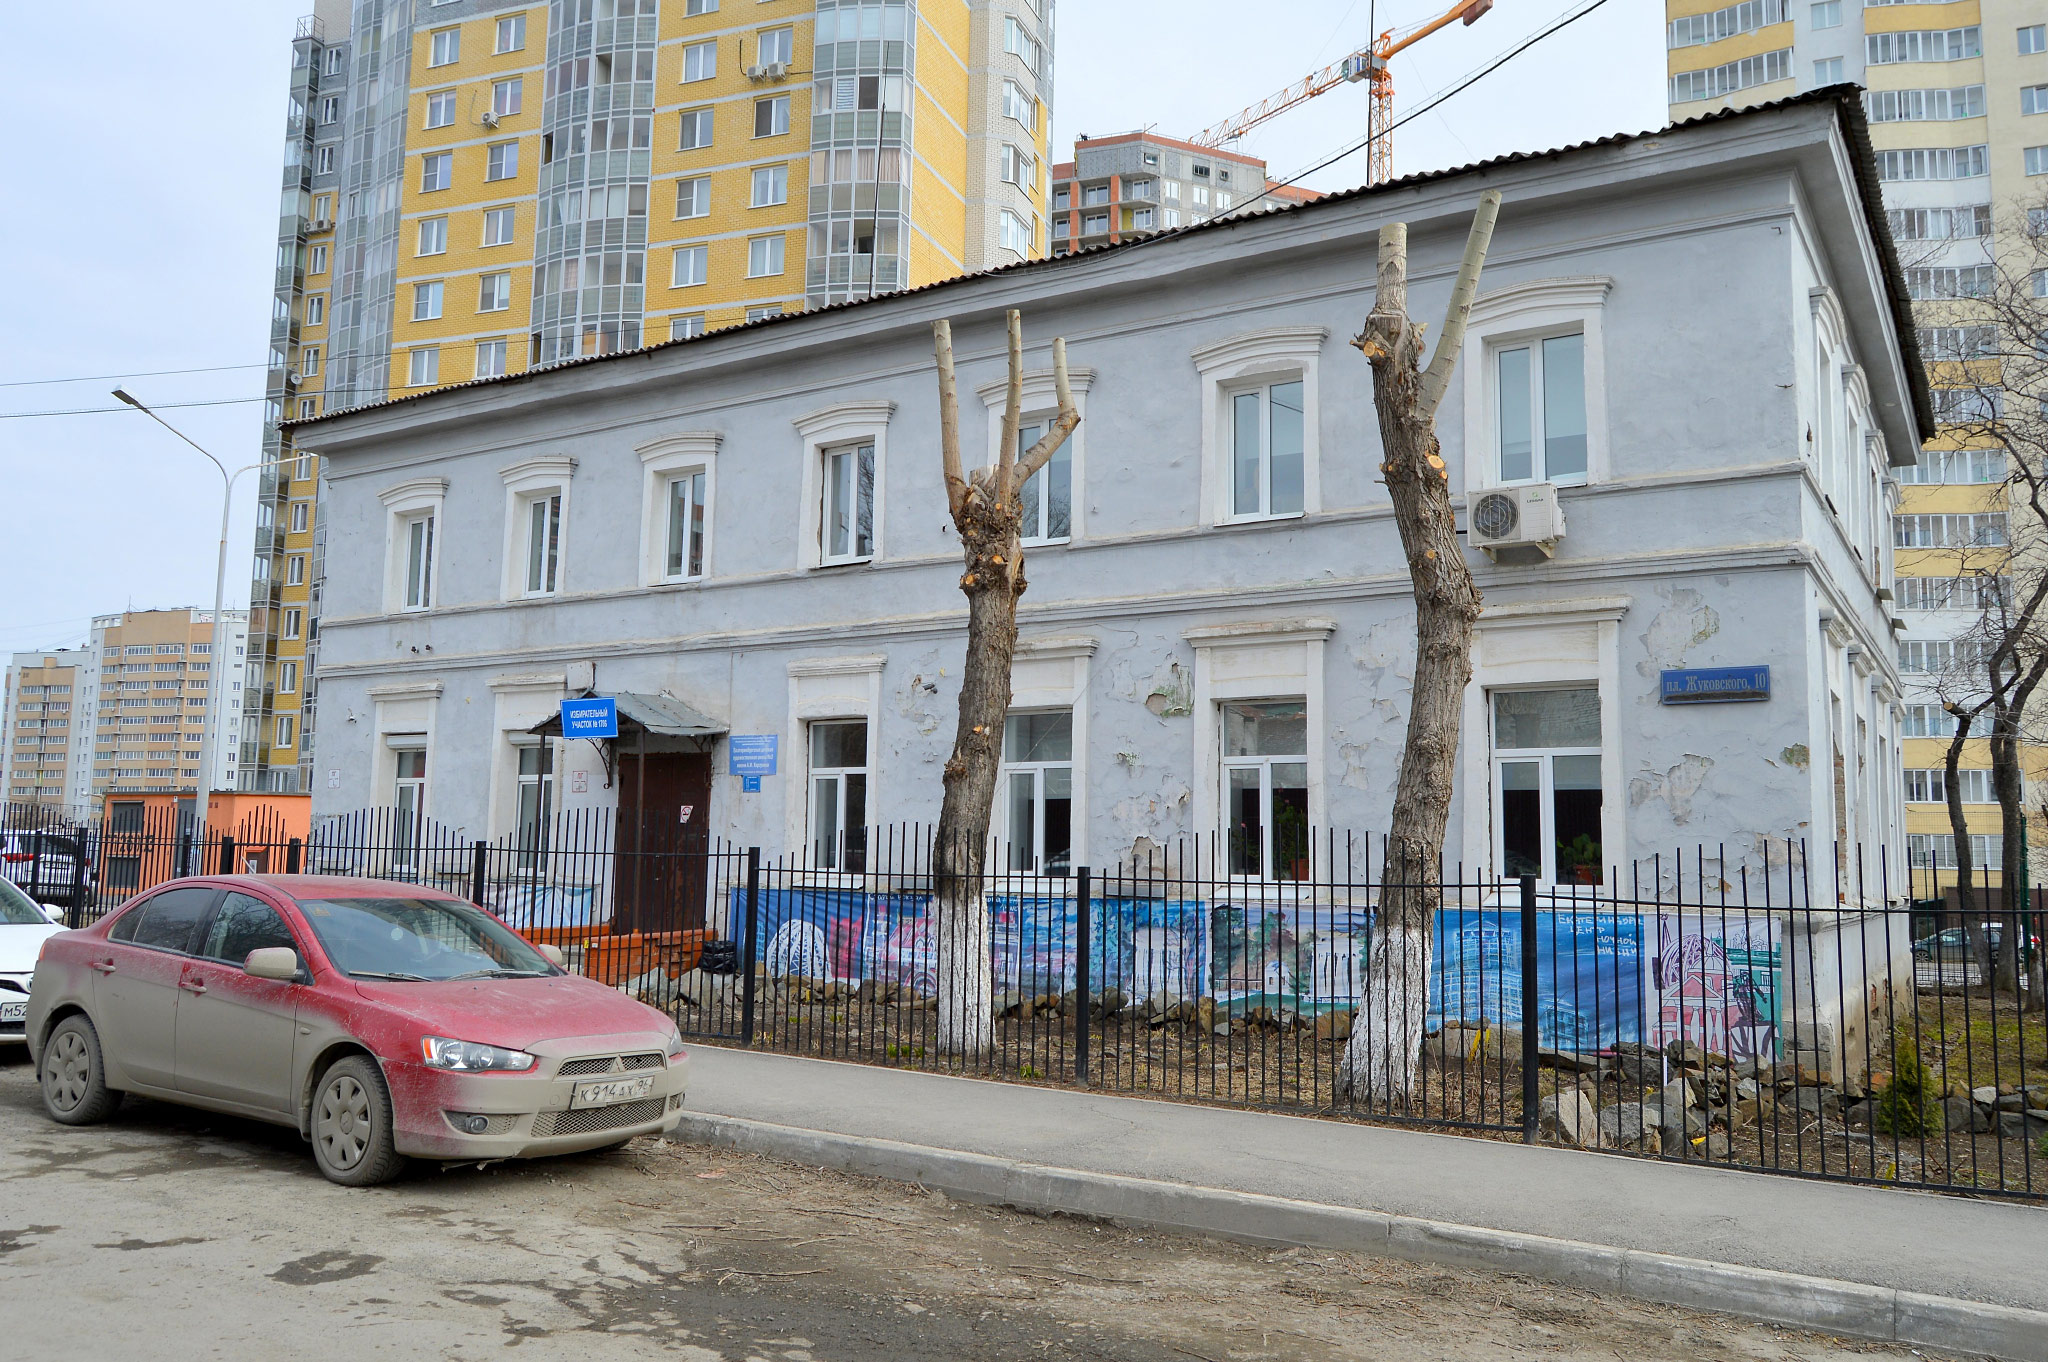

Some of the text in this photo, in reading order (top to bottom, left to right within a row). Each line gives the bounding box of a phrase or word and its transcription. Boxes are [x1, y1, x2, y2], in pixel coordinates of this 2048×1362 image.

[1666, 681, 1682, 692] пл.
[1754, 672, 1766, 689] 10
[570, 707, 608, 719] ИЗБИРАТЕЛЬНЫЙ
[571, 719, 592, 729] УЧАСТОК
